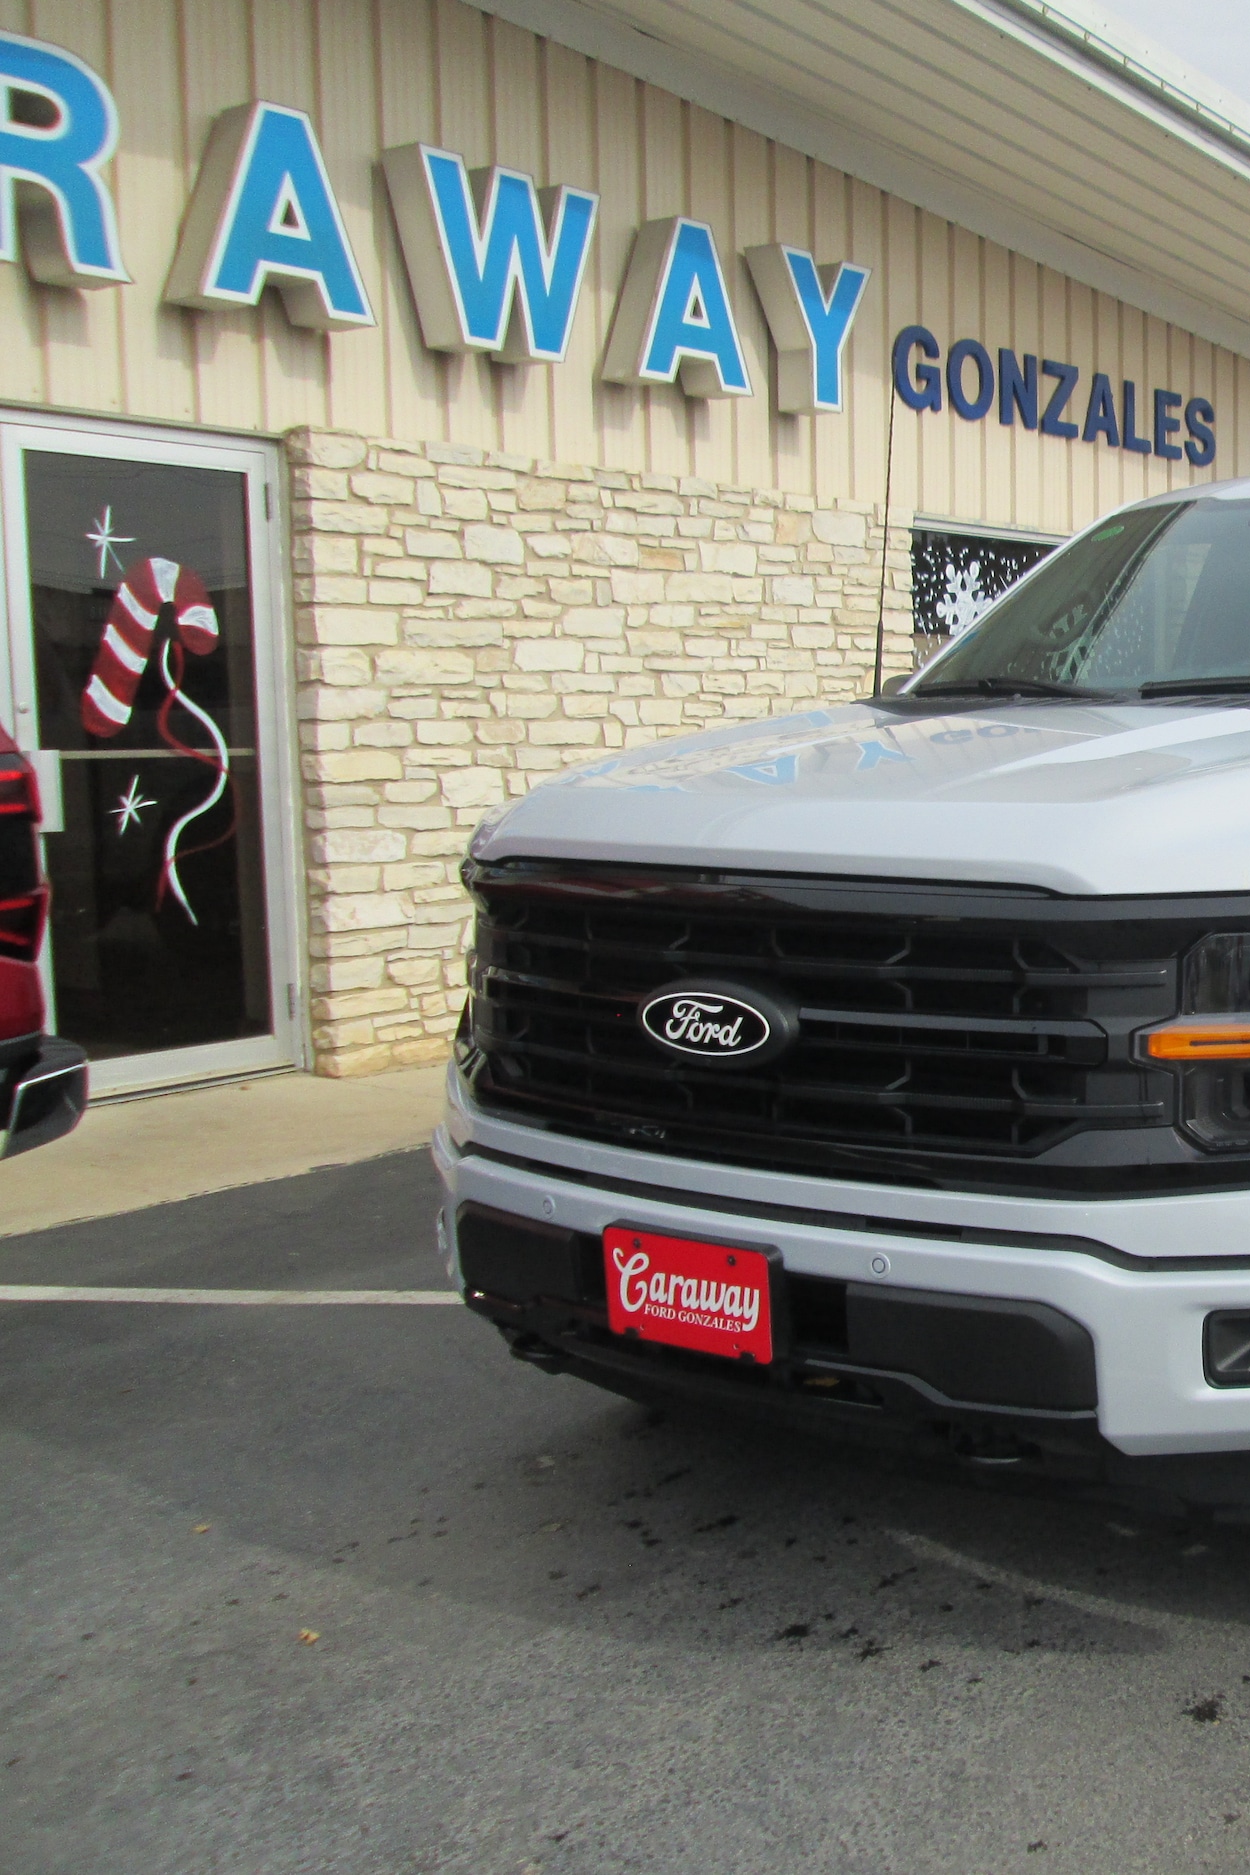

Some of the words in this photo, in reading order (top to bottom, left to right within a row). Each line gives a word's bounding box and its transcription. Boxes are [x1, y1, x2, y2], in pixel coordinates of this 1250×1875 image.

[0, 29, 874, 414] RAWAY
[892, 325, 1217, 467] GONZALES
[665, 999, 744, 1047] Ford
[612, 1247, 760, 1333] Caraway
[643, 1303, 676, 1320] FORD
[678, 1310, 742, 1333] GONZALES
